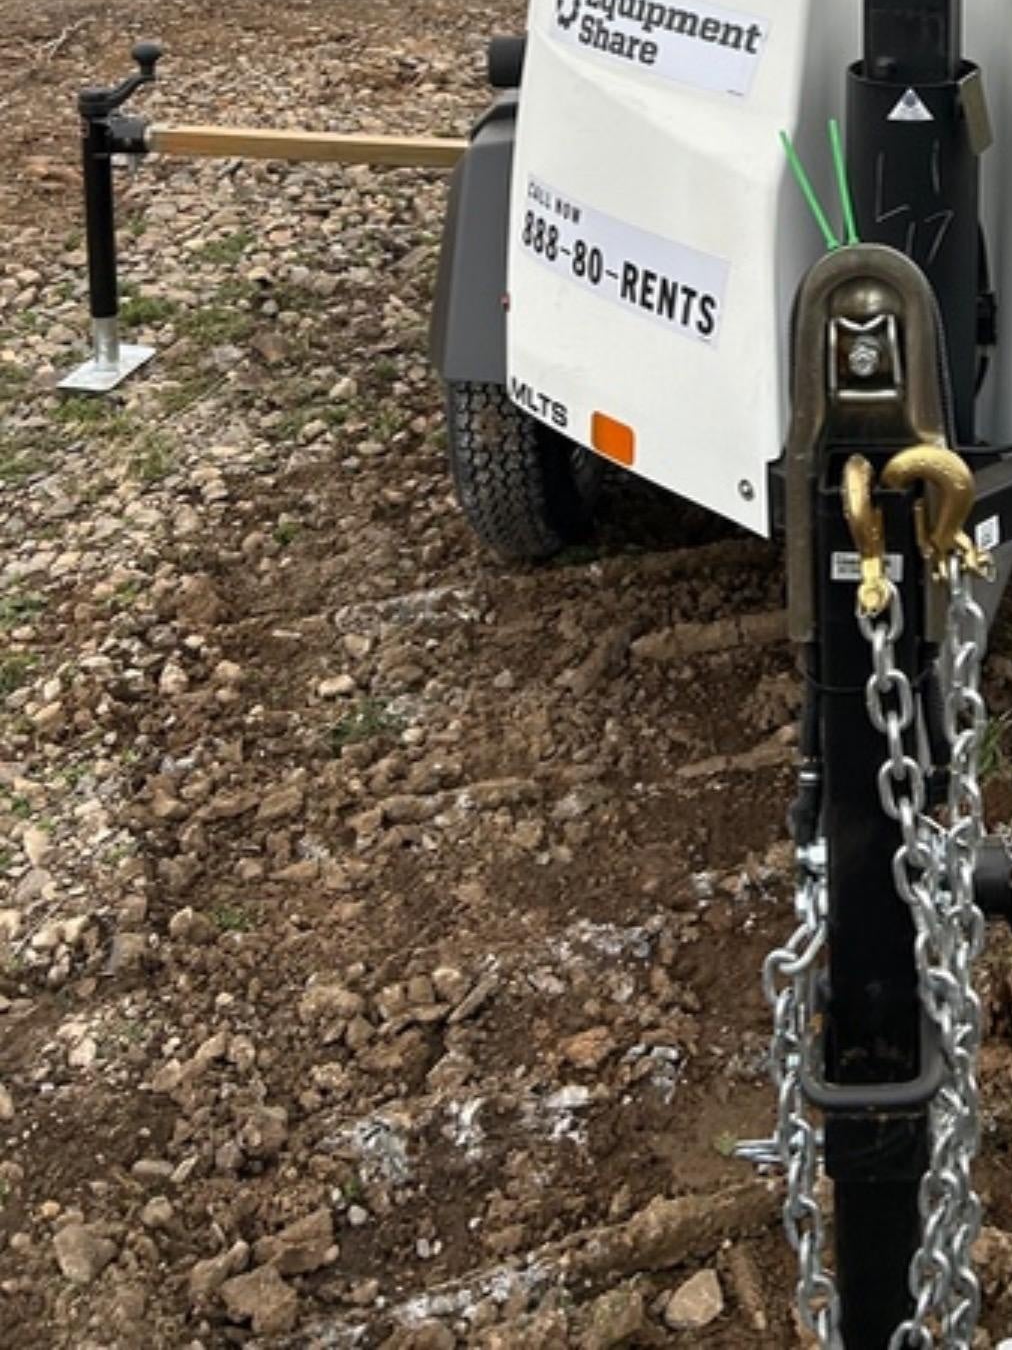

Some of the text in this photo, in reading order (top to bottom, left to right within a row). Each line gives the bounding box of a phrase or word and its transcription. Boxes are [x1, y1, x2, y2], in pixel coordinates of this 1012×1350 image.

[578, 14, 659, 65] Share
[554, 198, 582, 224] NOW
[521, 209, 717, 336] 888-80-RENTS
[511, 376, 568, 428] MLTS
